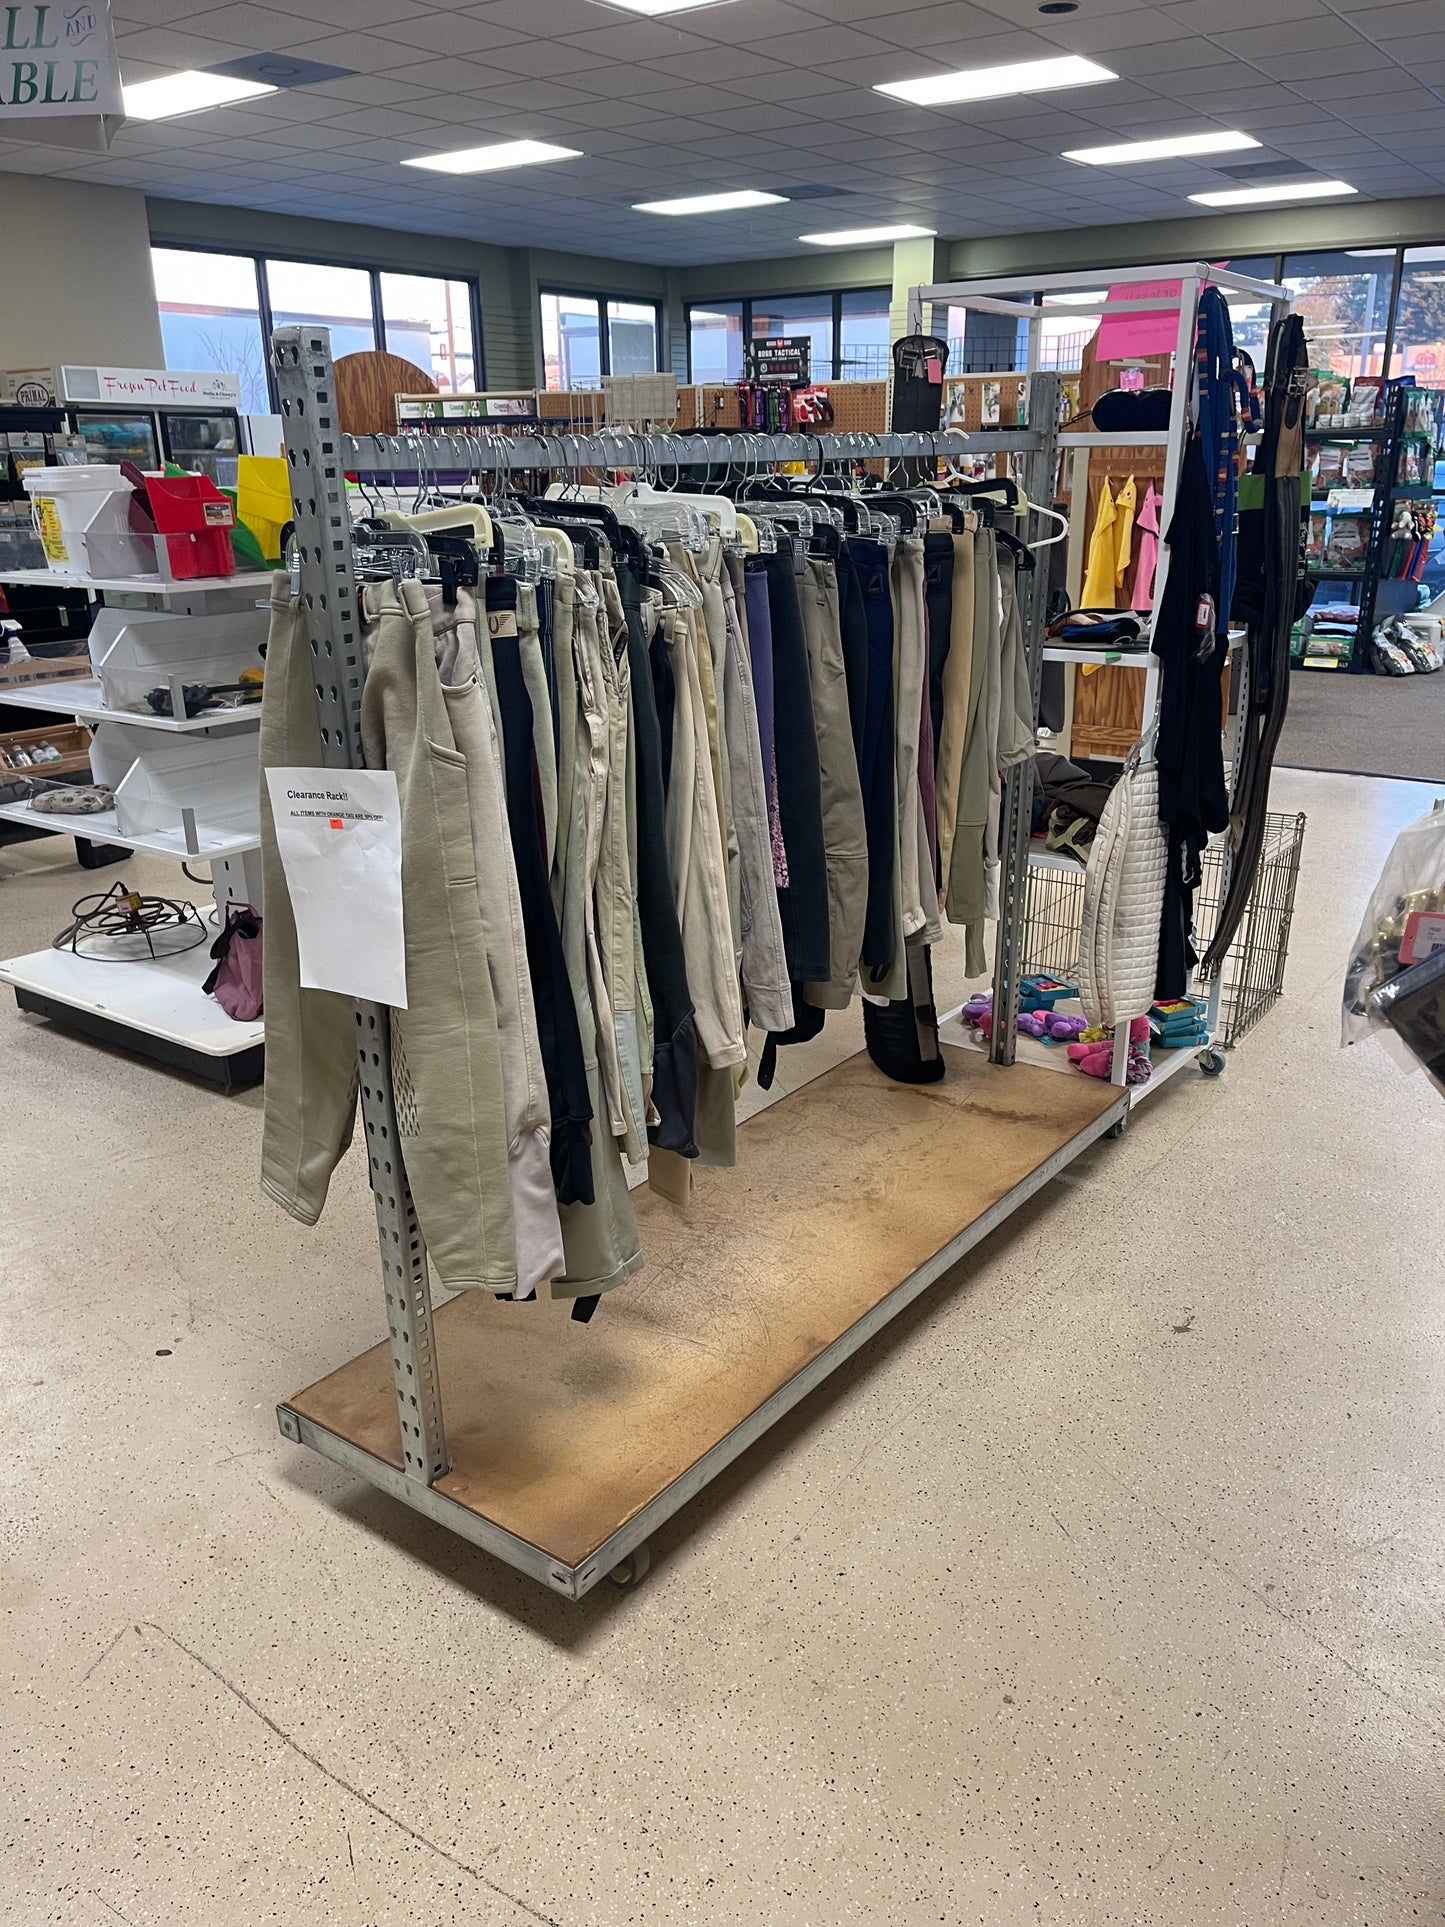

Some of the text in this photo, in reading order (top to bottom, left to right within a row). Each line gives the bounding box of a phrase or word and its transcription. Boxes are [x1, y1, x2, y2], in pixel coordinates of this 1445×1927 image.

[1, 5, 97, 49] LL AND
[757, 348, 801, 358] BOSS TACTICAL
[103, 376, 197, 398] Frozen Pet Food
[20, 389, 47, 403] PRIMAL
[287, 790, 348, 801] Clearance Rack!!
